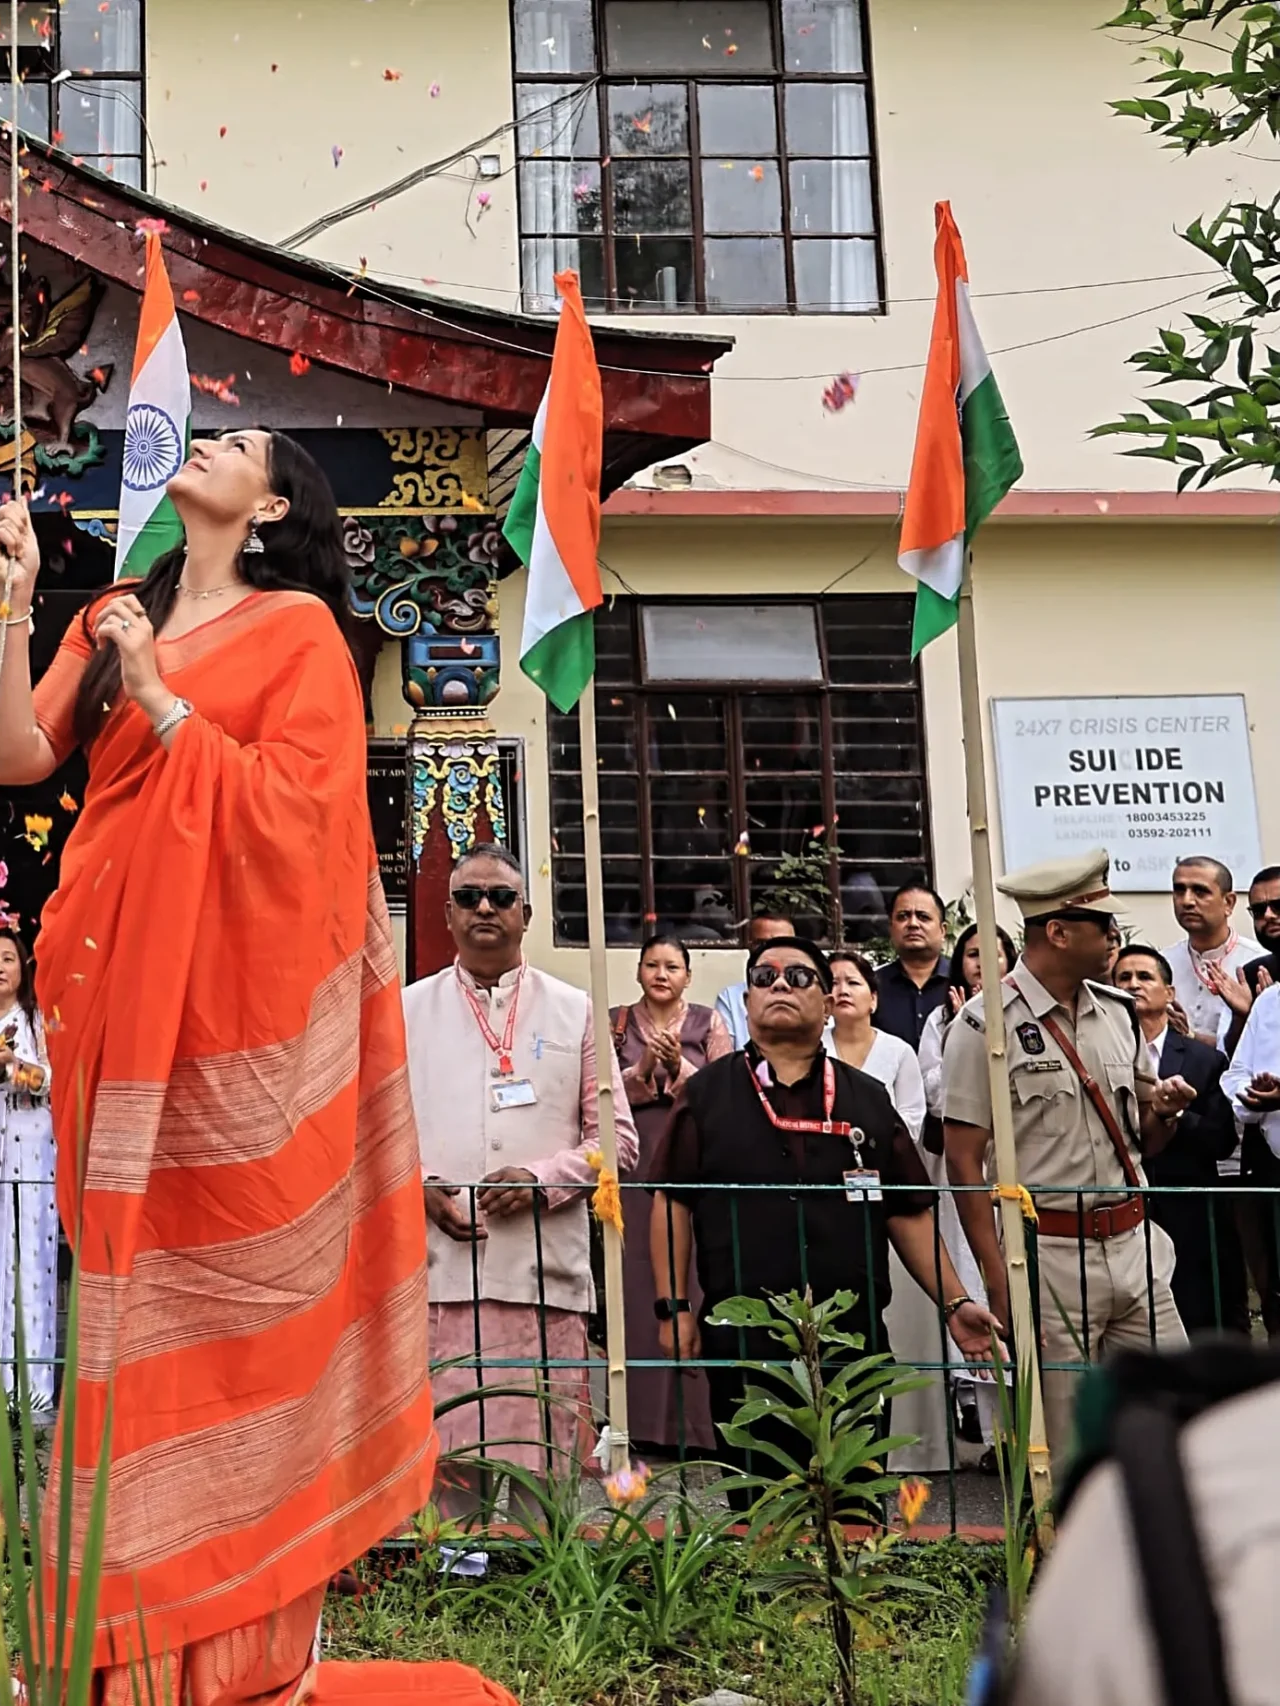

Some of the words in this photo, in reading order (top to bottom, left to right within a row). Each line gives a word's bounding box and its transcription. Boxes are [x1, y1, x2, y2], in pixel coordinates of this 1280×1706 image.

[1016, 719, 1061, 736] 24X7
[1070, 717, 1138, 735] CRISIS
[1145, 715, 1231, 734] CENTER
[1034, 781, 1225, 807] PREVENTION
[1126, 811, 1207, 823] 18003453225
[1128, 827, 1212, 839] 03592-202111
[1114, 857, 1131, 873] to
